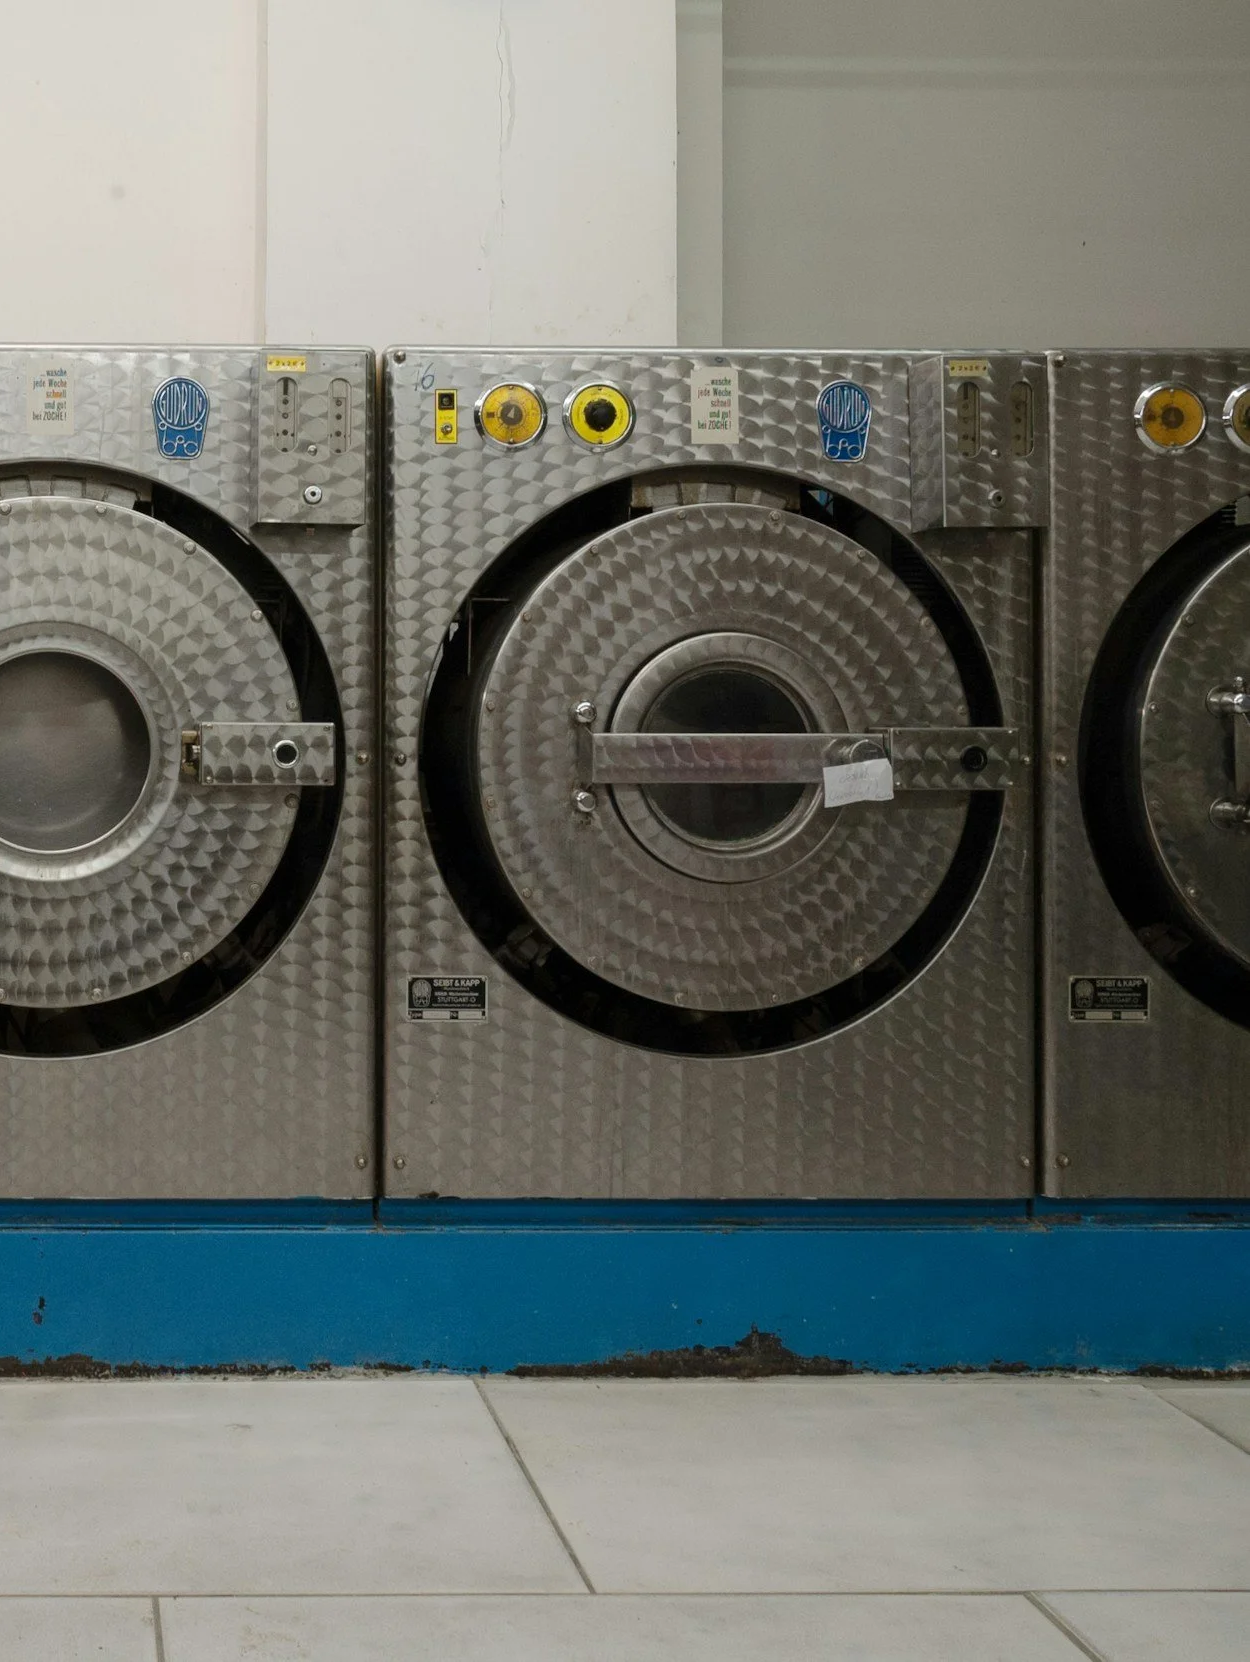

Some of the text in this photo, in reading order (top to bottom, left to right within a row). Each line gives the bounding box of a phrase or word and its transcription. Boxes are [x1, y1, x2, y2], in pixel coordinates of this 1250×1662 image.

[33, 379, 67, 390] jede Woche
[46, 390, 67, 398] schnell
[697, 388, 732, 399] jede Woche
[44, 401, 55, 409] und
[159, 383, 202, 425] GUDRUN
[711, 399, 731, 408] schnell
[822, 386, 866, 430] GUDRUN
[32, 412, 42, 421] bei
[709, 410, 720, 418] und
[697, 420, 707, 429] bei
[460, 979, 480, 987] KAPP
